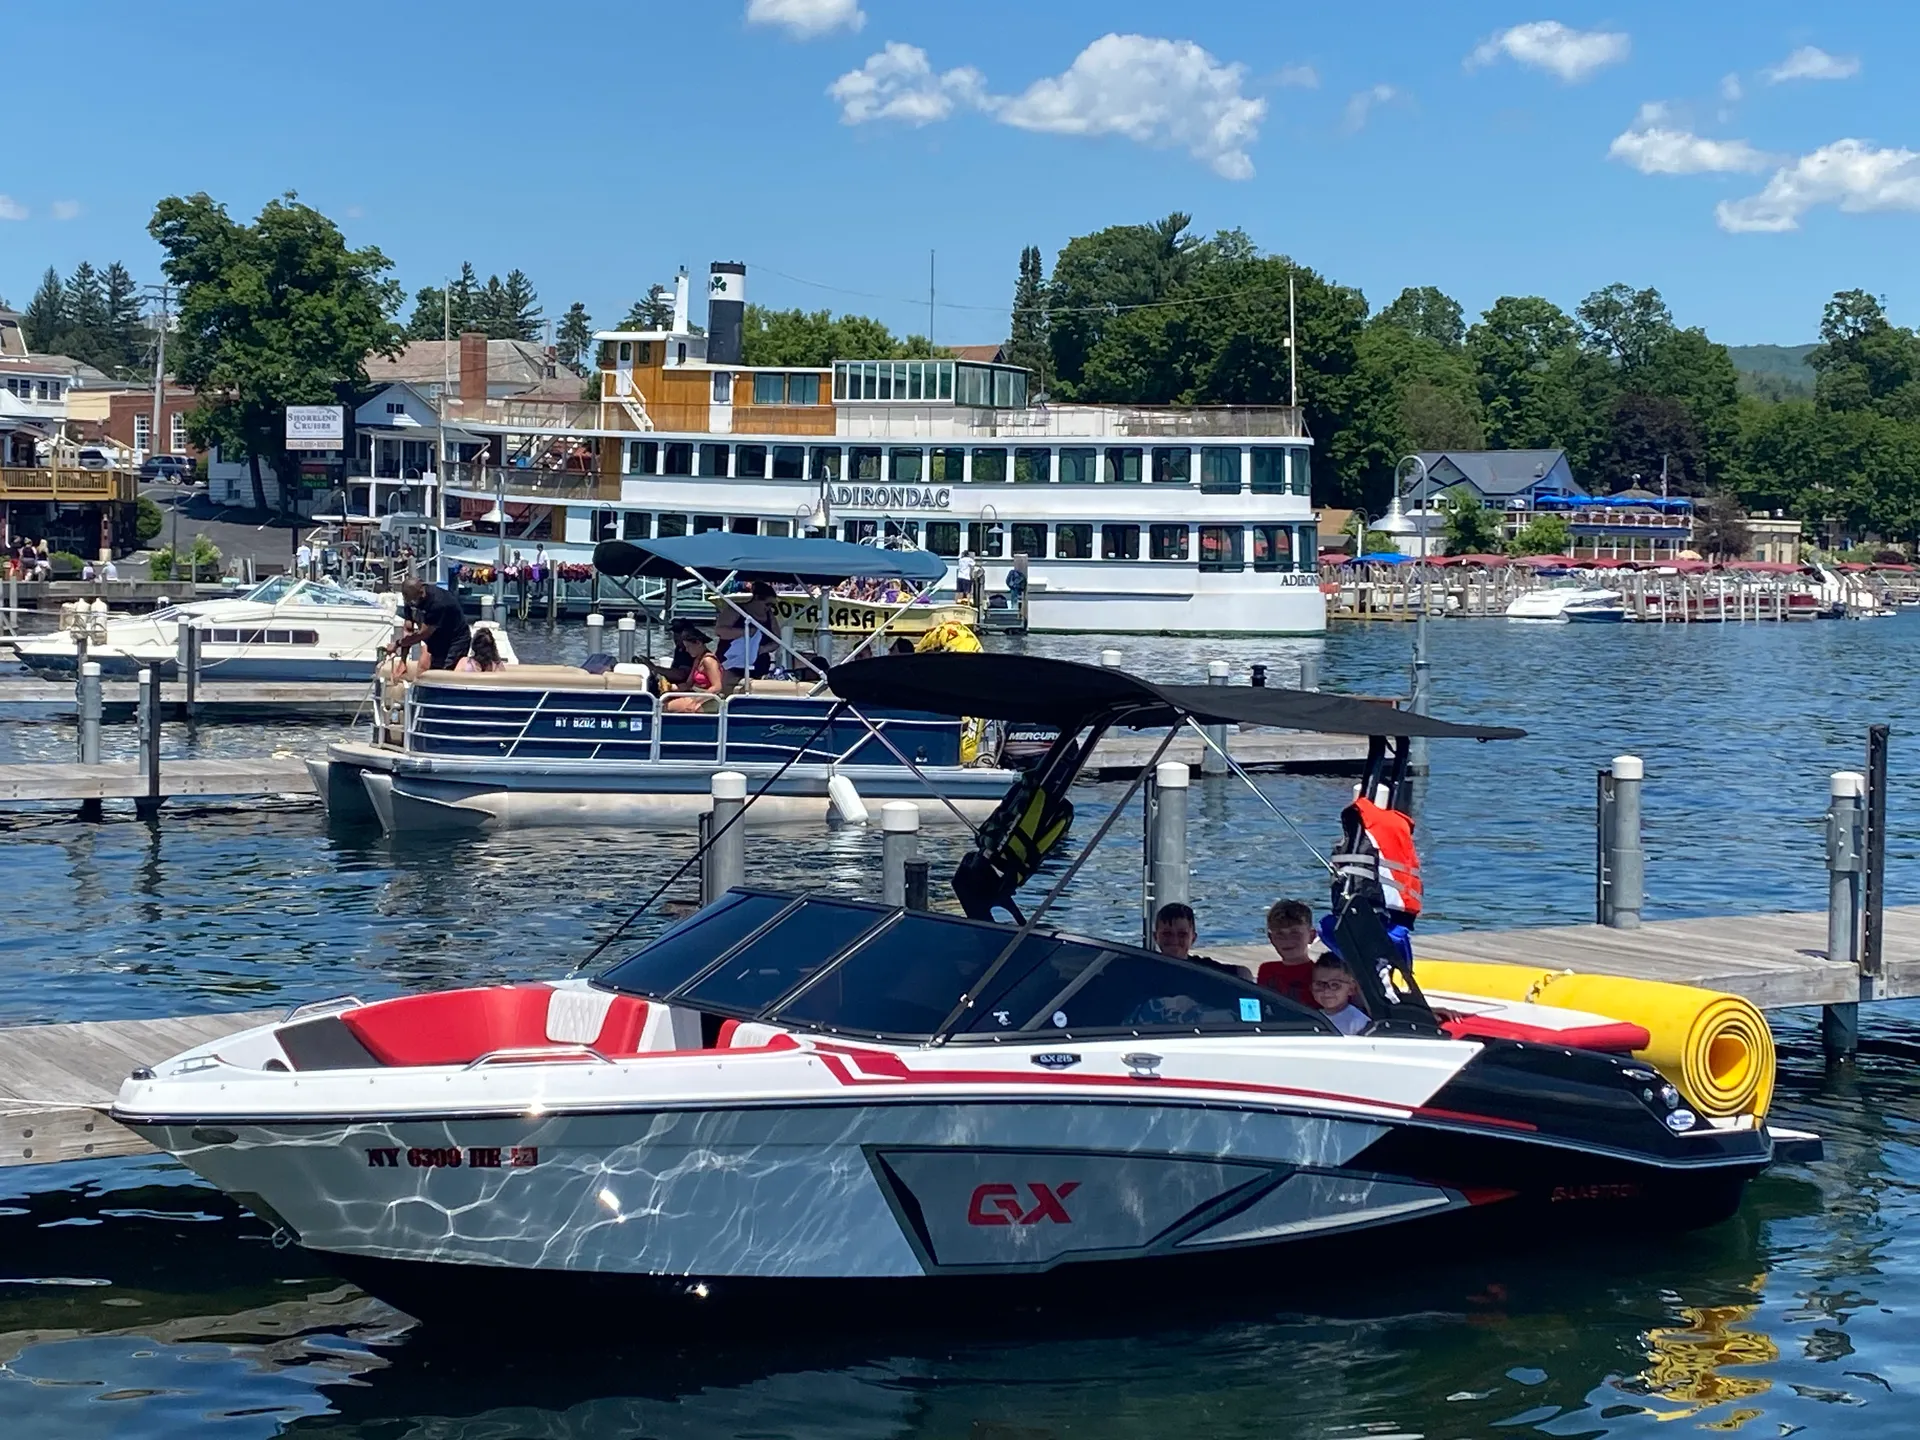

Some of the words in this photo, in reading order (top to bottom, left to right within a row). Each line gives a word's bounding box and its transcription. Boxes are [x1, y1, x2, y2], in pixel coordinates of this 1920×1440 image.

[827, 485, 950, 508] ADIRONDAC
[1008, 732, 1060, 740] MERCURY
[367, 1148, 400, 1167] NY
[1551, 1184, 1640, 1202] GLASTRO
[968, 1182, 1082, 1225] GX
